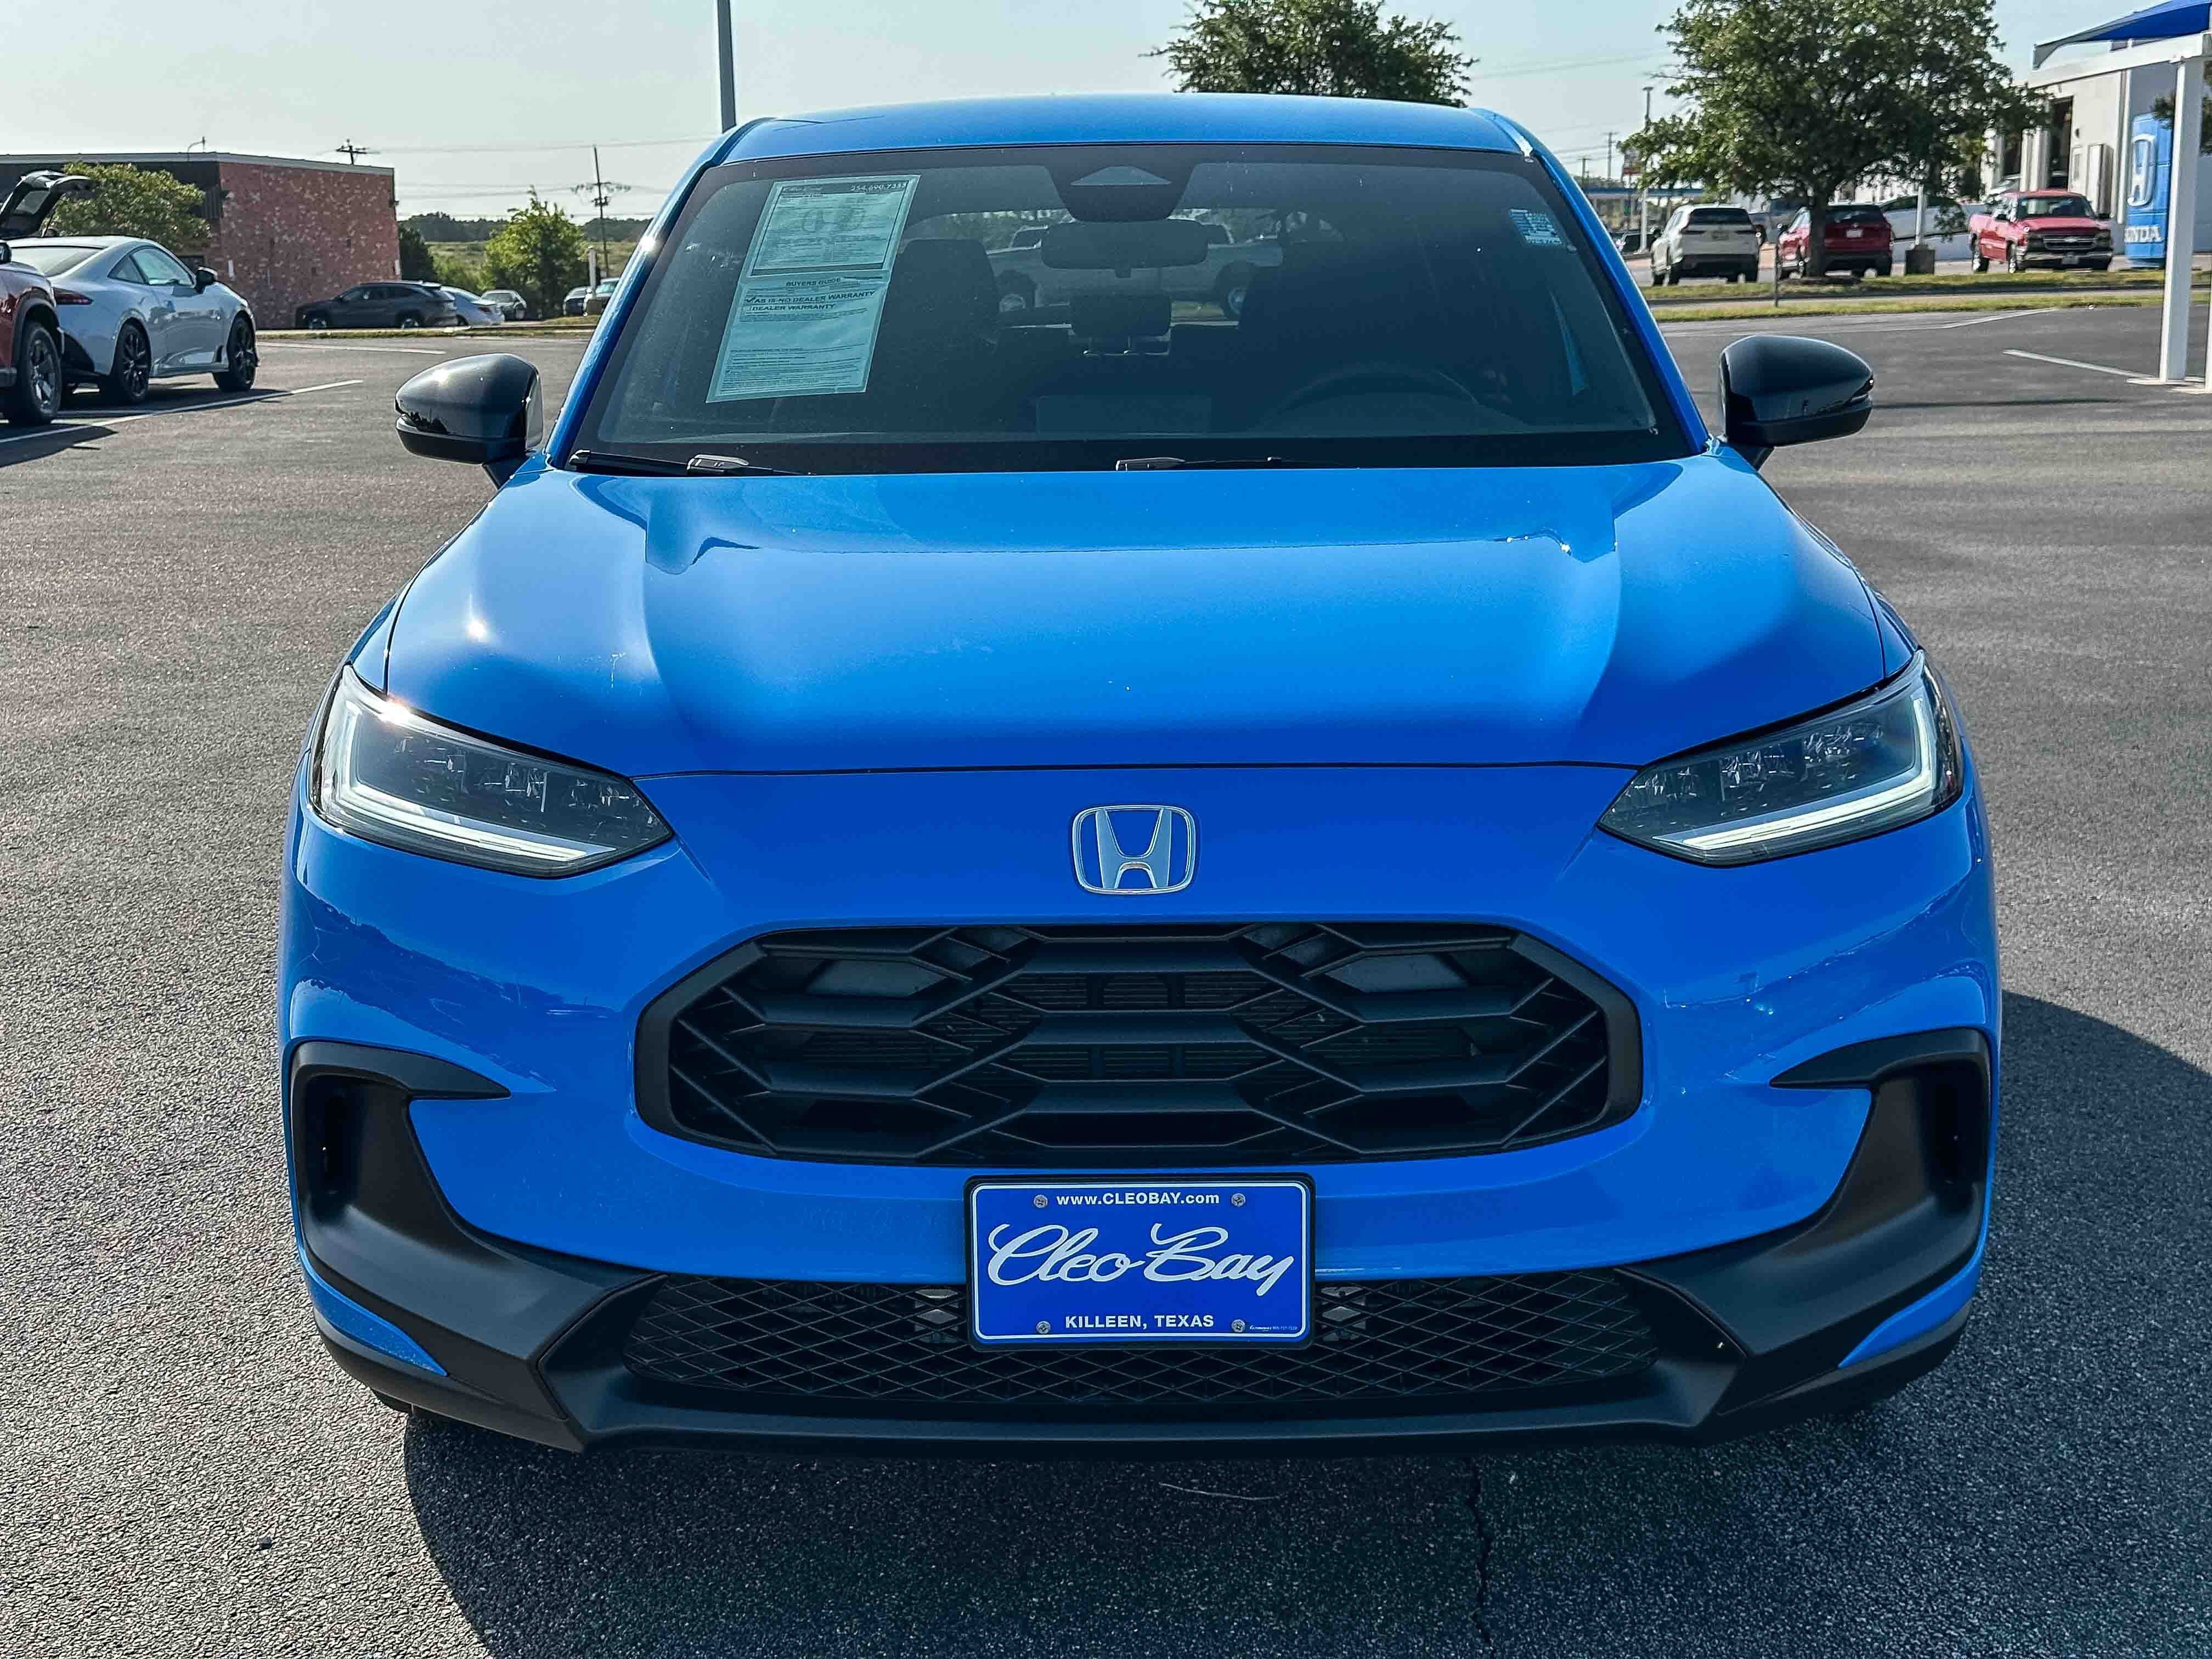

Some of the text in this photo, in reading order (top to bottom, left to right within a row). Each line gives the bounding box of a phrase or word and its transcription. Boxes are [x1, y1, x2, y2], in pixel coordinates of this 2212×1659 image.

[828, 290, 876, 300] WARRANTY
[1056, 1192, 1220, 1205] www.CLEOBAY.com
[988, 1223, 1294, 1296] Cleo Bay
[1065, 1314, 1214, 1330] KILLEEN, TEXAS
